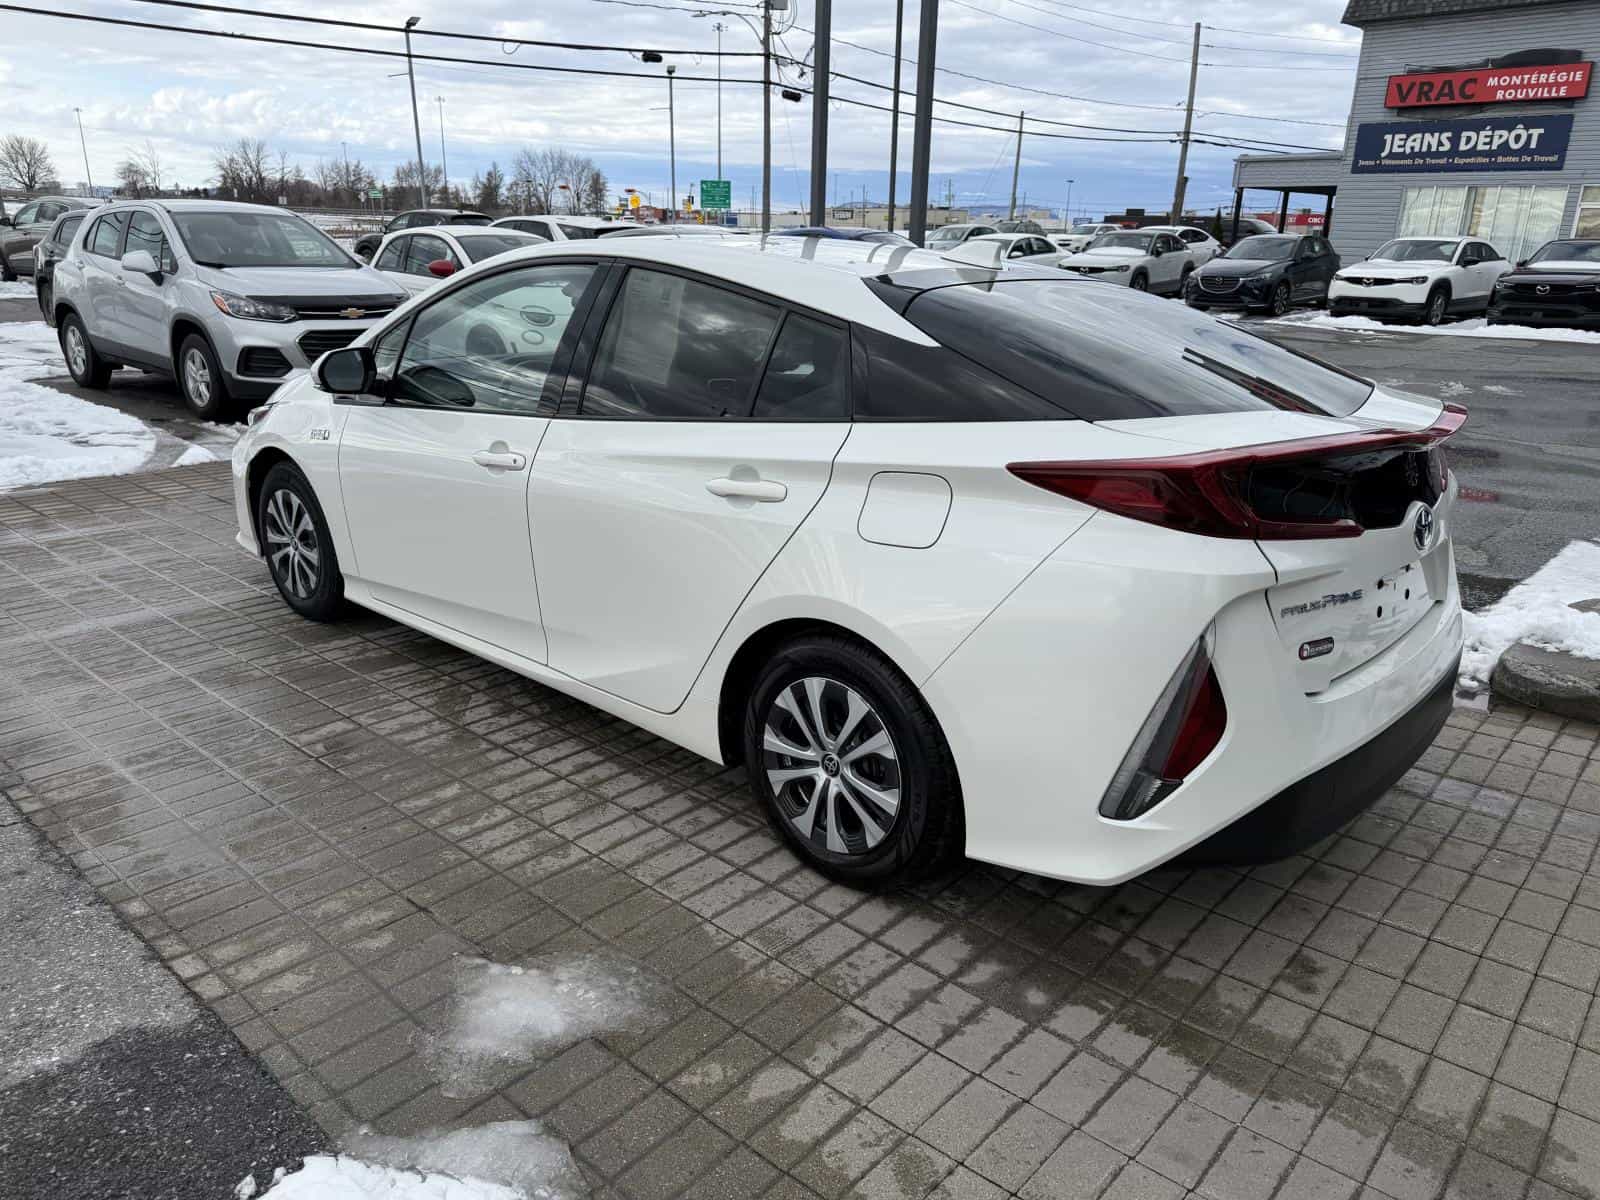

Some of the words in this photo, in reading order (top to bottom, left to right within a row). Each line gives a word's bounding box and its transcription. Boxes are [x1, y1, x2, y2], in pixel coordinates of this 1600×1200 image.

[1487, 71, 1584, 87] MONTÉRÉGIE
[1396, 78, 1478, 103] VRAC
[1496, 86, 1568, 100] ROUVILLE
[1381, 132, 1453, 158] JEANS
[1458, 124, 1544, 150] DÉPÔT
